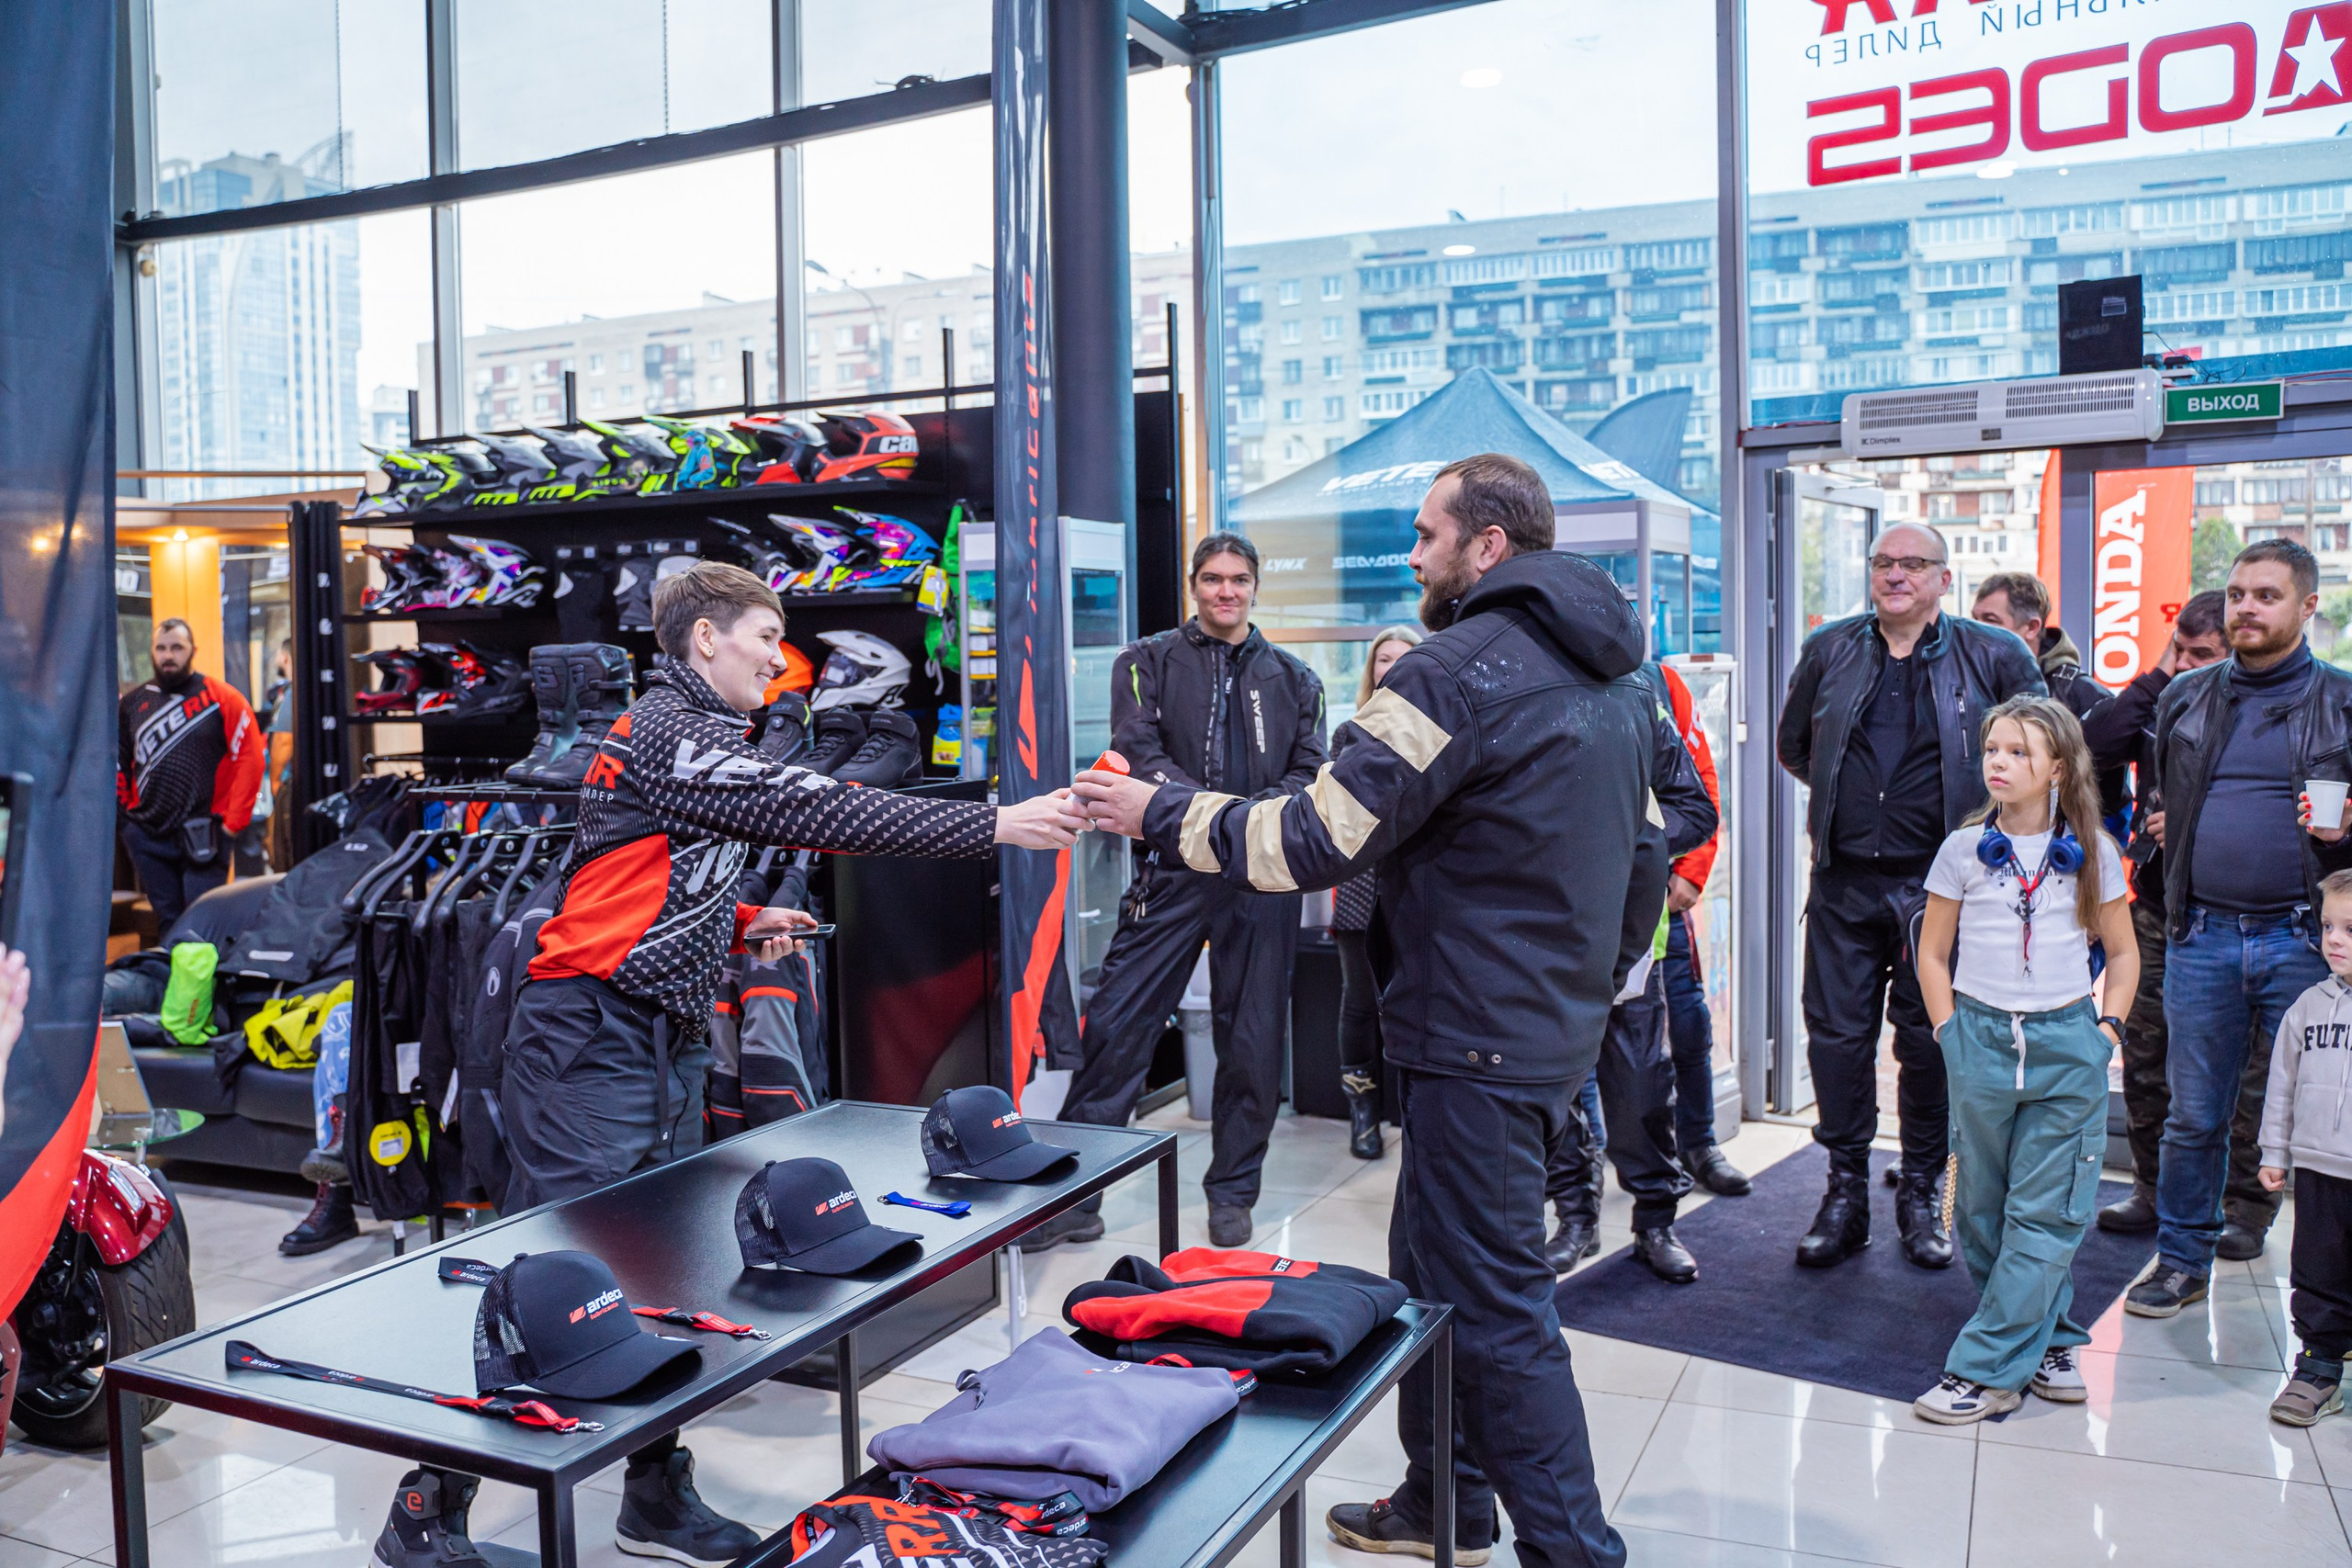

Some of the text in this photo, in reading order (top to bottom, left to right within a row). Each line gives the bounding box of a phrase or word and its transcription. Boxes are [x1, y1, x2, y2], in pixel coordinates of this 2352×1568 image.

[2188, 393, 2260, 412] ВЫХОД
[1870, 436, 1901, 445] Dimplex
[1322, 460, 1450, 492] VETE
[1263, 557, 1308, 573] LYNX
[2093, 490, 2147, 695] ONDA
[581, 787, 614, 803] ИЛЕР
[250, 1359, 281, 1369] ardeca
[1057, 1517, 1087, 1536] ardeca
